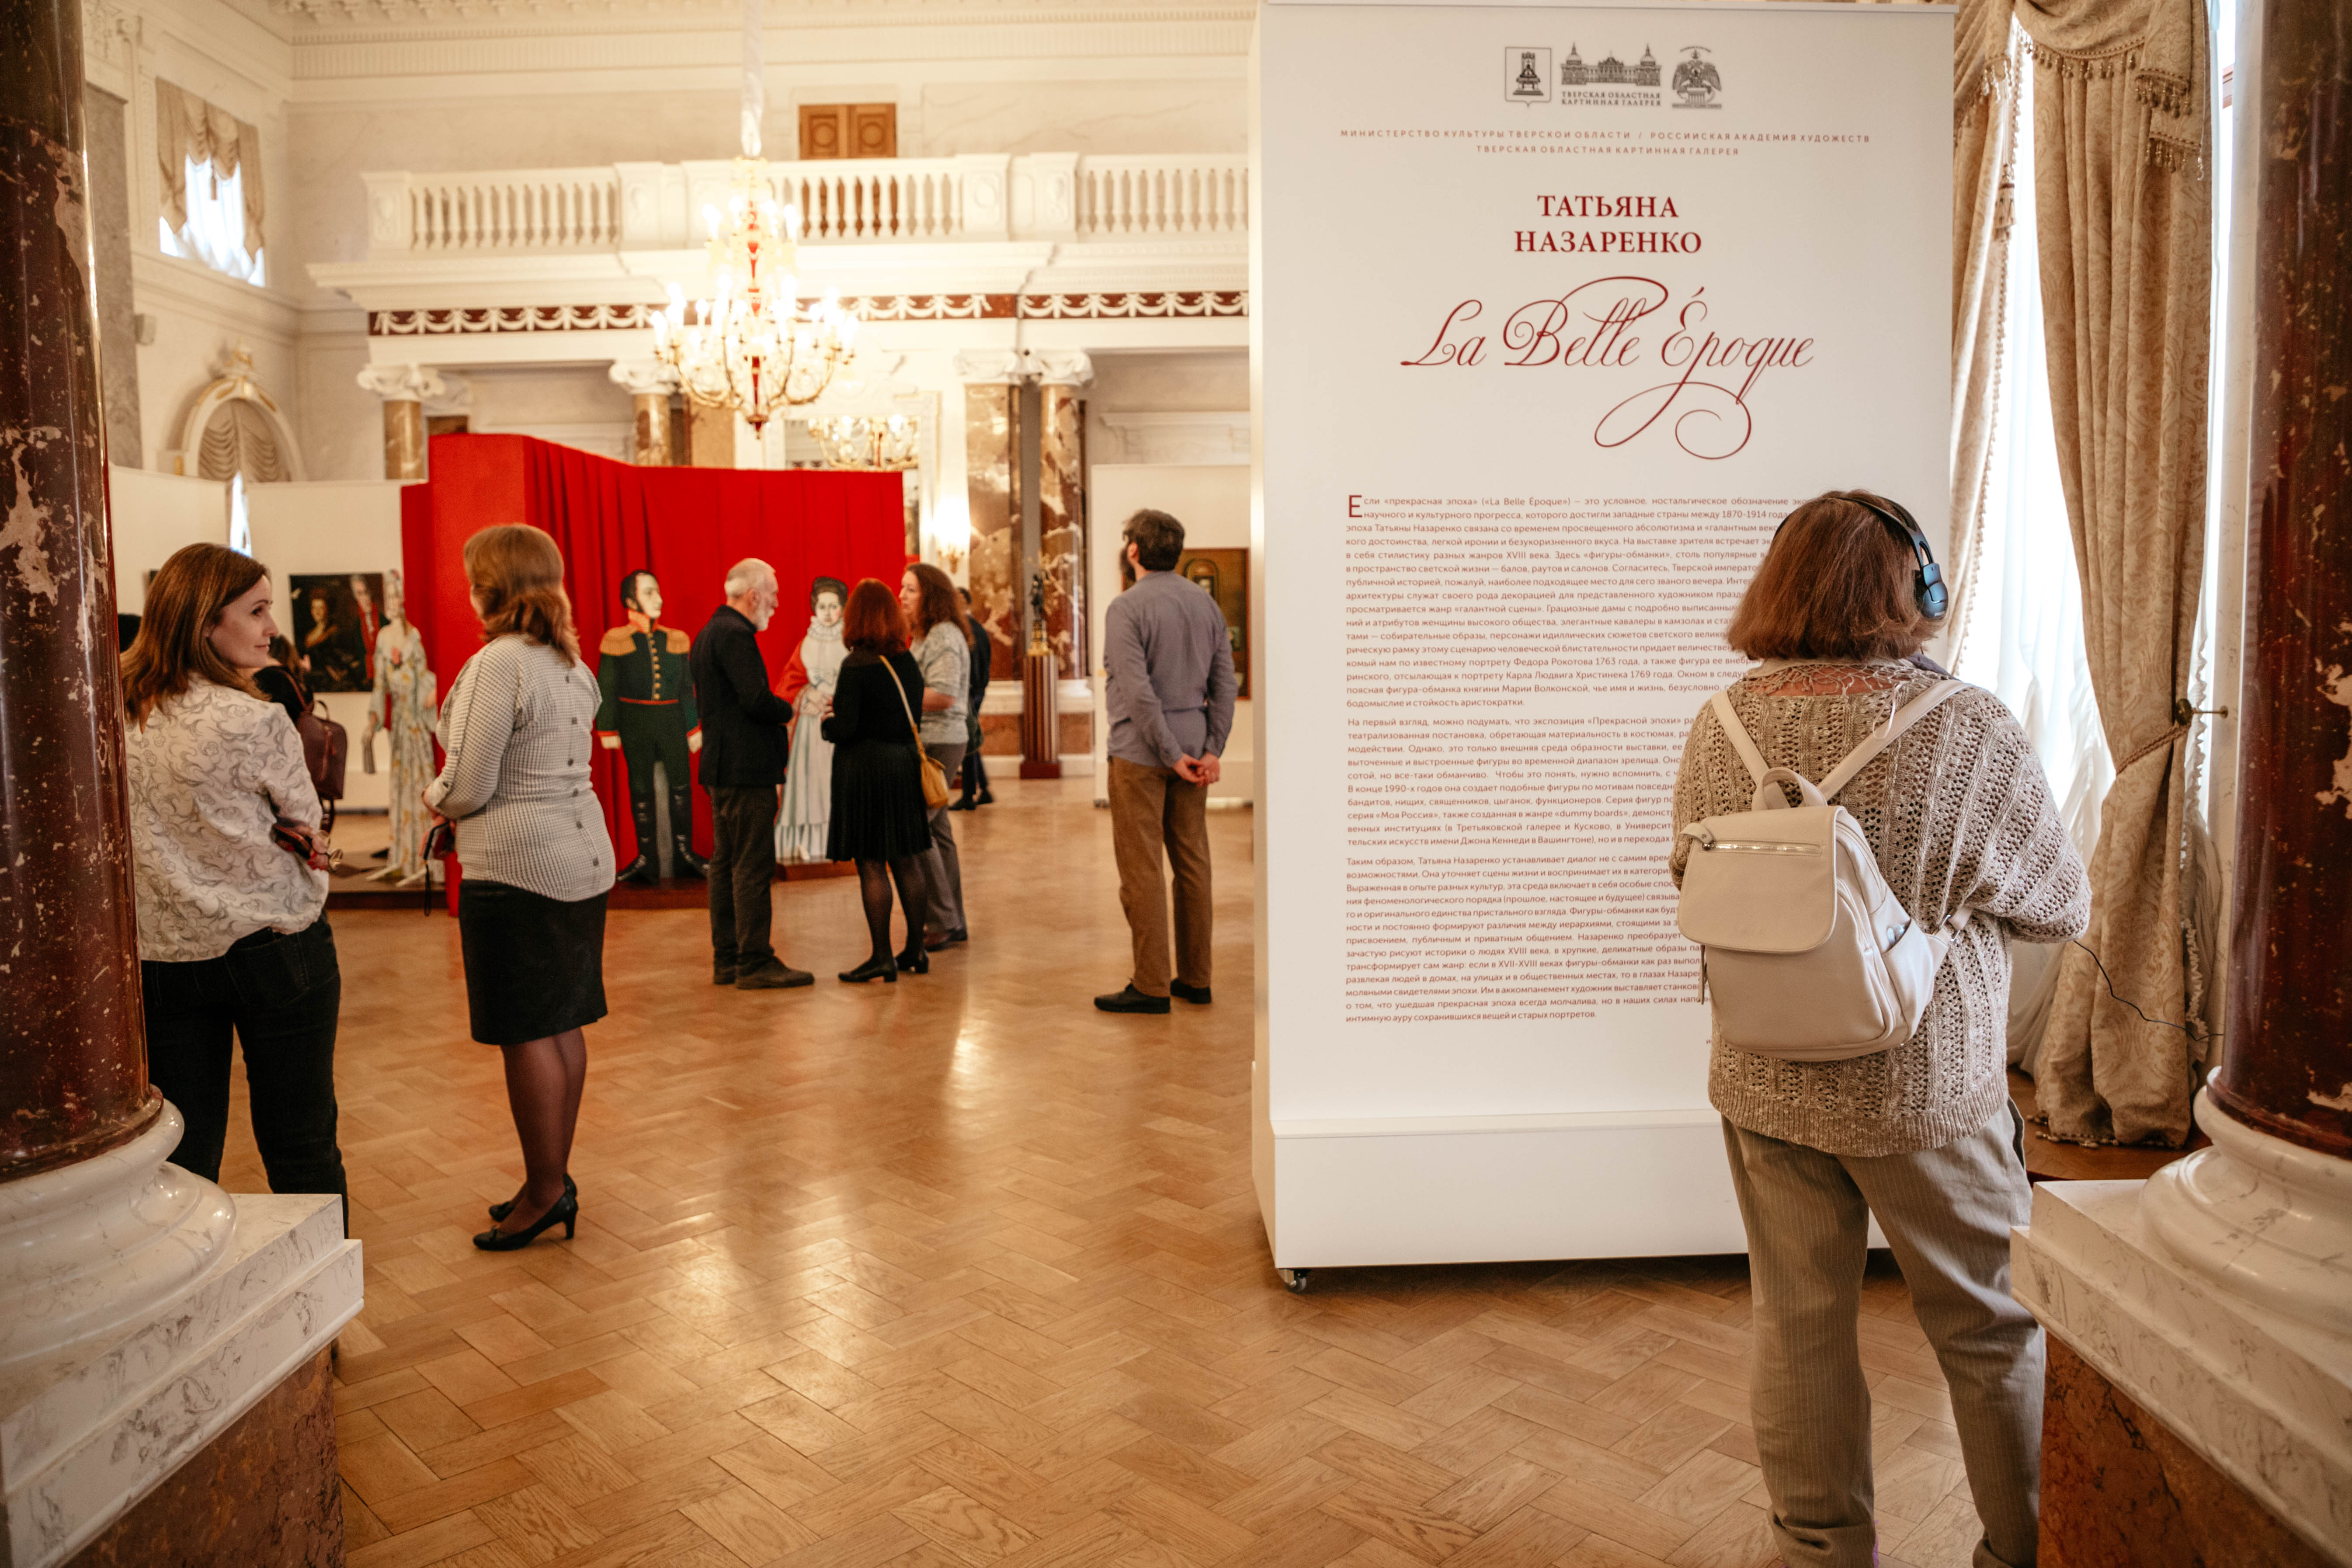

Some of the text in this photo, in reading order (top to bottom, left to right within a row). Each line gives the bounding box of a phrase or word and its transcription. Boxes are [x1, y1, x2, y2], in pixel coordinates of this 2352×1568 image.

[1341, 129, 1439, 138] МИНИСТЕРСТВО
[1444, 130, 1504, 139] КУЛЬТУРЫ
[1734, 133, 1796, 142] АКАДЕМИЯ
[1800, 135, 1869, 143] ХУДОЖЕСТВ
[1540, 146, 1611, 154] ОБЛАСТНАЯ
[1689, 147, 1738, 156] ГАЛЕРЕЯ
[1537, 195, 1679, 218] ТАТЬЯНА
[1514, 231, 1702, 254] НАЗАРЕНКО
[1400, 300, 1487, 366] La
[1503, 276, 1669, 366] Belle
[1504, 497, 1525, 506] Belle
[1731, 497, 1788, 505] обозначение
[1374, 524, 1411, 532] Татьяны
[1413, 524, 1462, 534] Назаренко
[1562, 525, 1633, 534] просвещенного
[1636, 523, 1695, 532] абсолютизма
[1354, 551, 1375, 559] себя
[1378, 553, 1430, 561] стилистику
[1434, 553, 1465, 561] разных
[1555, 551, 1580, 560] Здесь
[1476, 593, 1498, 601] рода
[1501, 591, 1556, 601] декорацией
[1547, 604, 1599, 614] Грациозные
[1635, 604, 1680, 613] подробно
[1469, 660, 1511, 668] портрету
[1514, 657, 1549, 668] Федора
[1551, 657, 1593, 666] Рокотова
[1679, 657, 1710, 666] фигура
[1386, 685, 1461, 695] фигура-обманка
[1502, 685, 1532, 694] Марии
[1363, 718, 1396, 727] первый
[1490, 731, 1546, 740] обретающая
[1348, 785, 1353, 793] В
[1500, 783, 1545, 793] подобные
[1547, 783, 1580, 793] фигуры
[1453, 857, 1500, 866] Назаренко
[1502, 857, 1565, 866] устанавливает
[1412, 935, 1461, 945] публичным
[1474, 936, 1522, 944] приватным
[1578, 933, 1624, 942] Назаренко
[1627, 932, 1681, 942] преобразует
[1393, 1015, 1413, 1023] ауру
[1482, 1012, 1510, 1020] вещей
